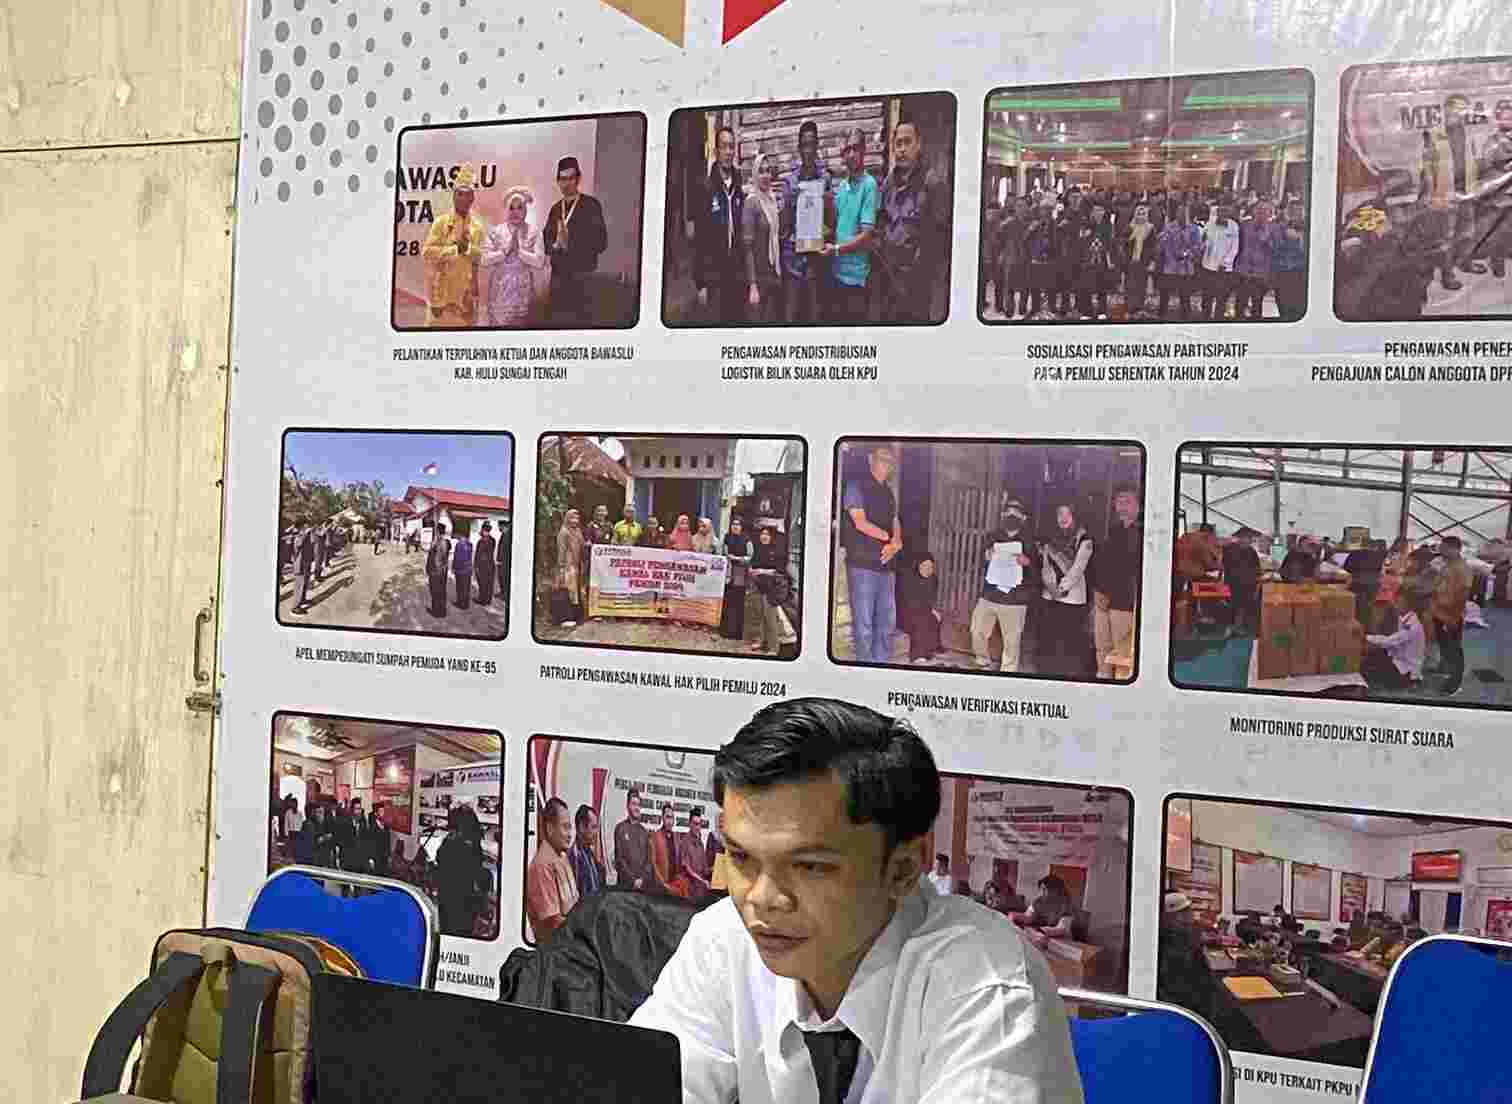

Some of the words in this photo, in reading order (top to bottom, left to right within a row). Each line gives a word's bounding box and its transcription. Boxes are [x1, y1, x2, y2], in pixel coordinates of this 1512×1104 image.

[392, 347, 444, 362] PELANTIKAN
[499, 347, 528, 361] KETUA
[529, 347, 547, 361] DAN
[549, 346, 589, 361] ANGGOTA
[590, 346, 634, 361] BAWASLU
[720, 345, 787, 360] PENGAWASAN
[788, 344, 877, 360] PENDISTRIBUSIAN
[1026, 344, 1092, 359] SOSIALISASI
[1095, 343, 1171, 358] PENGAWASAN
[1174, 343, 1248, 358] PARTISIPATIF
[1383, 342, 1470, 358] PENGAWASAN
[499, 367, 531, 380] SUNGAI
[533, 366, 567, 380] TENGAH
[721, 366, 764, 380] LOGISTIK
[766, 366, 792, 380] BILIK
[793, 366, 826, 380] SUARA
[828, 366, 855, 380] OLEH
[856, 366, 878, 380] KPU
[1065, 366, 1105, 381] PEMILU
[1108, 366, 1166, 381] SERENTAK
[1168, 366, 1205, 381] TAHUN
[1208, 366, 1239, 381] 2024
[1311, 365, 1382, 382] PENGAJUAN
[1385, 365, 1425, 382] CALON
[1428, 365, 1487, 382] ANGGOTA
[295, 647, 315, 660] APEL
[376, 652, 410, 667] SUMPAH
[411, 655, 445, 670] PEMUDA
[446, 657, 469, 672] YANG
[470, 660, 497, 674] KE-95
[539, 664, 576, 681] PATROLI
[577, 667, 639, 686] PENGAWASAN
[639, 672, 673, 689] KAWAL
[674, 674, 695, 690] HAK
[695, 676, 720, 692] PILIH
[722, 678, 758, 695] PEMILU
[760, 681, 786, 697] 2024
[887, 691, 958, 711] PENGAWASAN
[960, 697, 1019, 715] VERIFIKASI
[1020, 701, 1070, 719] FAKTUAL
[1229, 717, 1304, 737] MONITORING
[1306, 722, 1368, 743] PRODUKSI
[1369, 727, 1409, 745] SURAT
[1411, 730, 1455, 748] SUARA
[446, 970, 496, 990] KECAMATAN
[1244, 1068, 1255, 1081] DI
[1256, 1070, 1278, 1085] KPU
[1279, 1073, 1323, 1092] TERKAIT
[1324, 1079, 1354, 1097] PKPU
